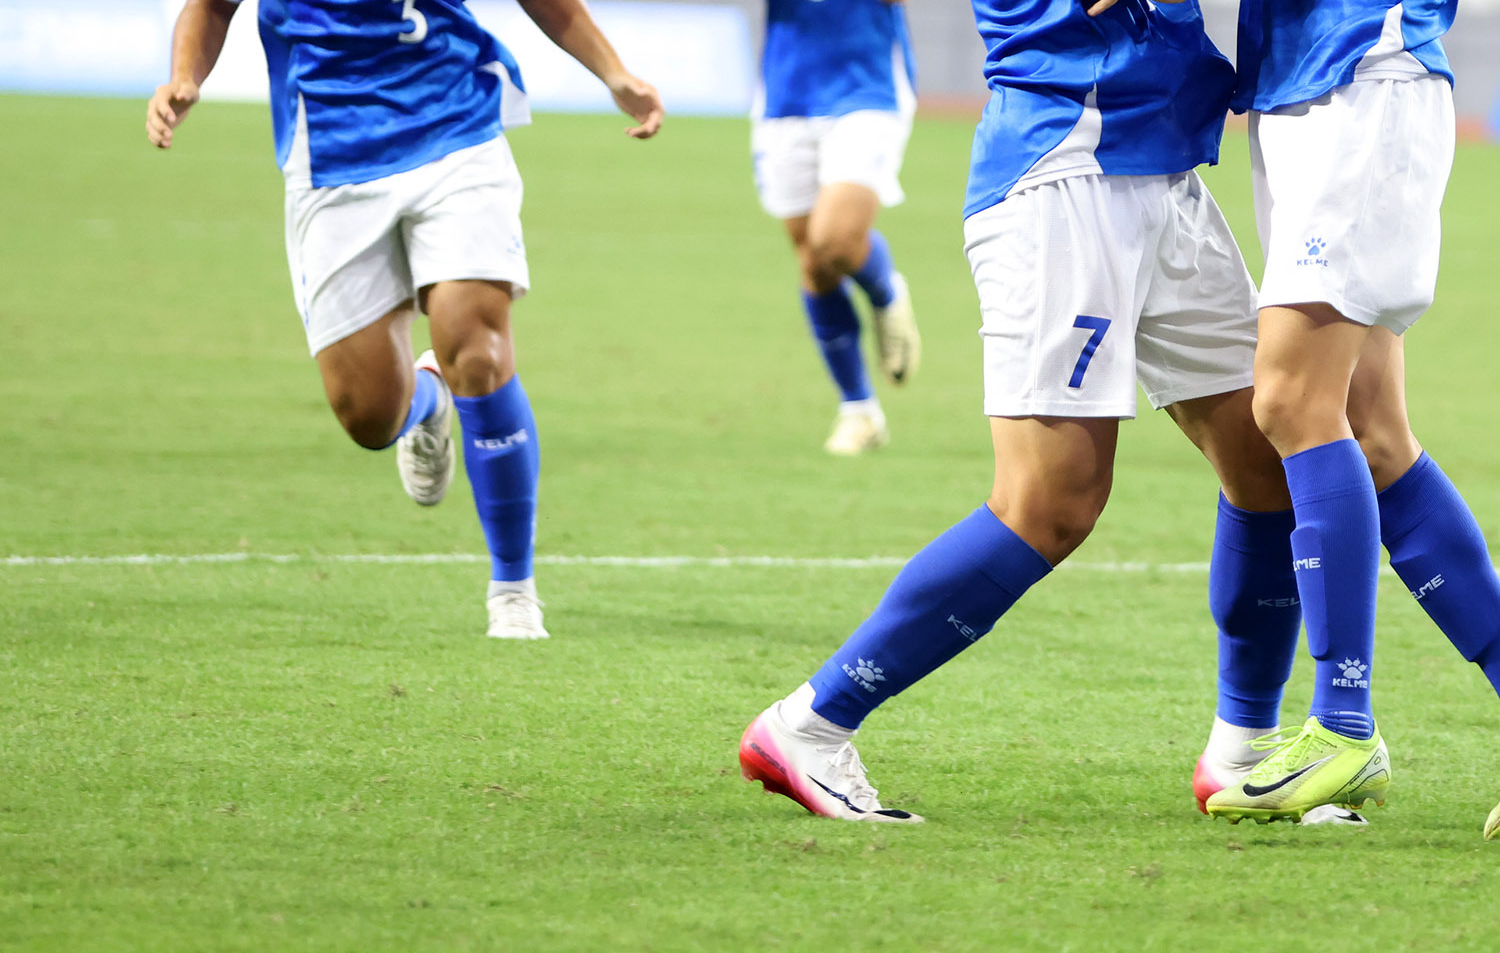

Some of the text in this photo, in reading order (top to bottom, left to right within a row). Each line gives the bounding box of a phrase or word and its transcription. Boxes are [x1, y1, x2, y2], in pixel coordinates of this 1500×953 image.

[1296, 258, 1329, 268] KELME
[1068, 315, 1112, 389] 7
[841, 663, 878, 693] KELME
[1332, 677, 1369, 689] KELME
